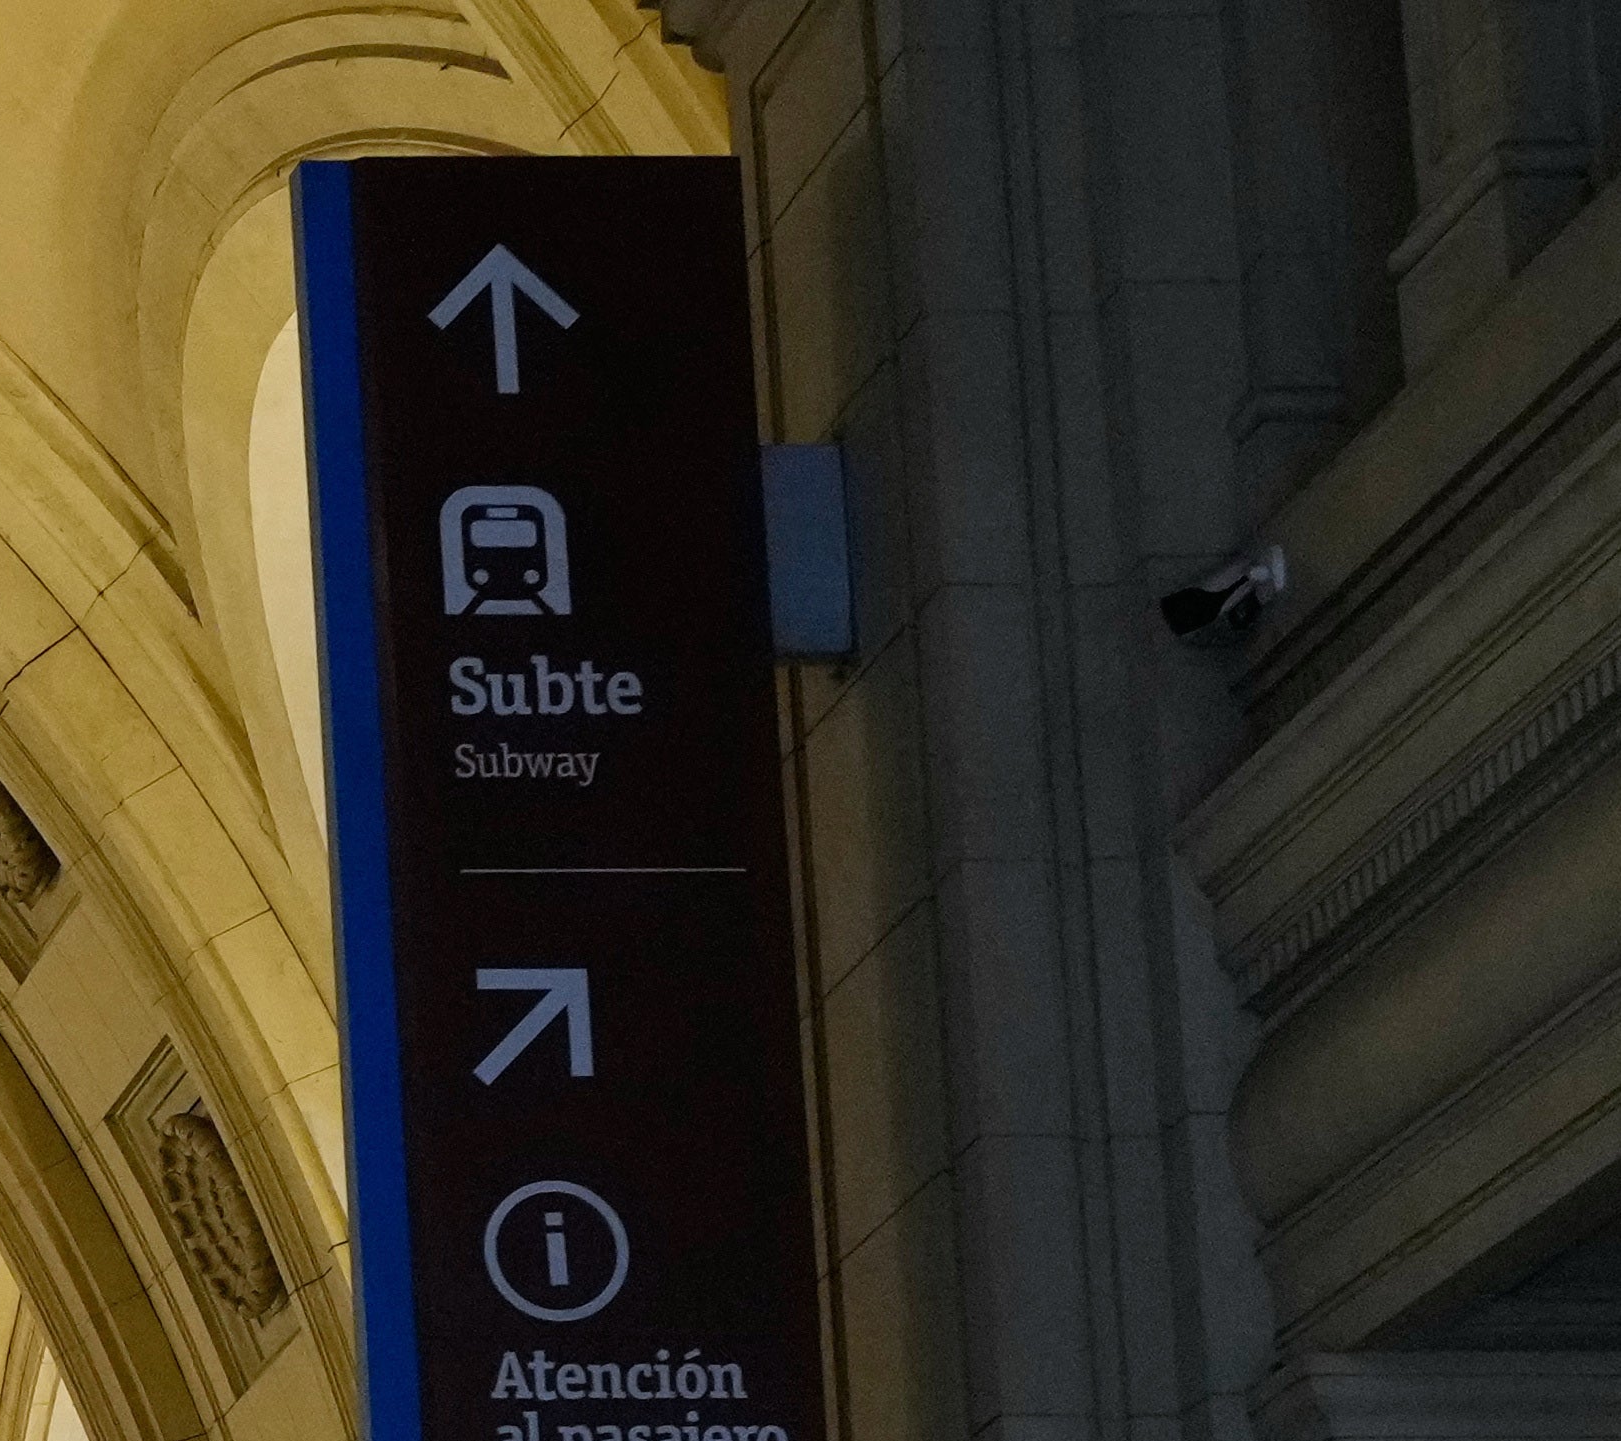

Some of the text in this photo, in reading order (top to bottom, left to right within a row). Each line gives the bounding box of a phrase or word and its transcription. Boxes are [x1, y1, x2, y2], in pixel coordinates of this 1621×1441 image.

[450, 655, 642, 715] Subte
[455, 743, 599, 786] Subway
[491, 1349, 747, 1401] Atención
